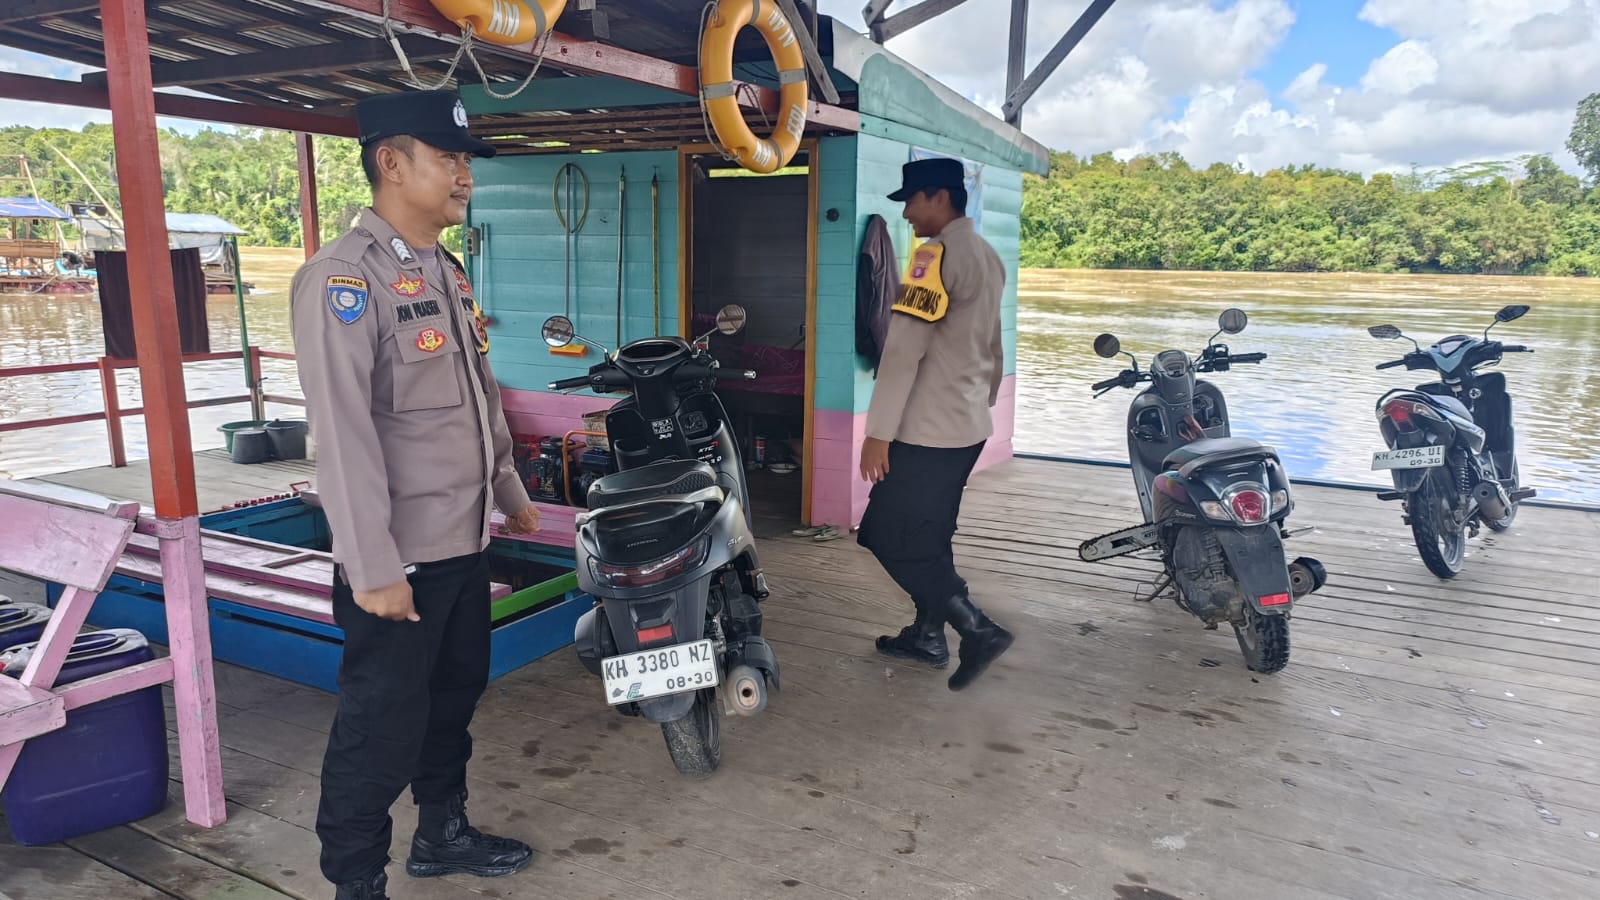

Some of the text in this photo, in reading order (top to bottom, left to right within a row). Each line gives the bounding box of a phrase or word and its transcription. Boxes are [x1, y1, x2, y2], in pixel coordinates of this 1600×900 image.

[331, 278, 364, 288] BINMAS
[605, 642, 711, 680] KH 3380 NZ
